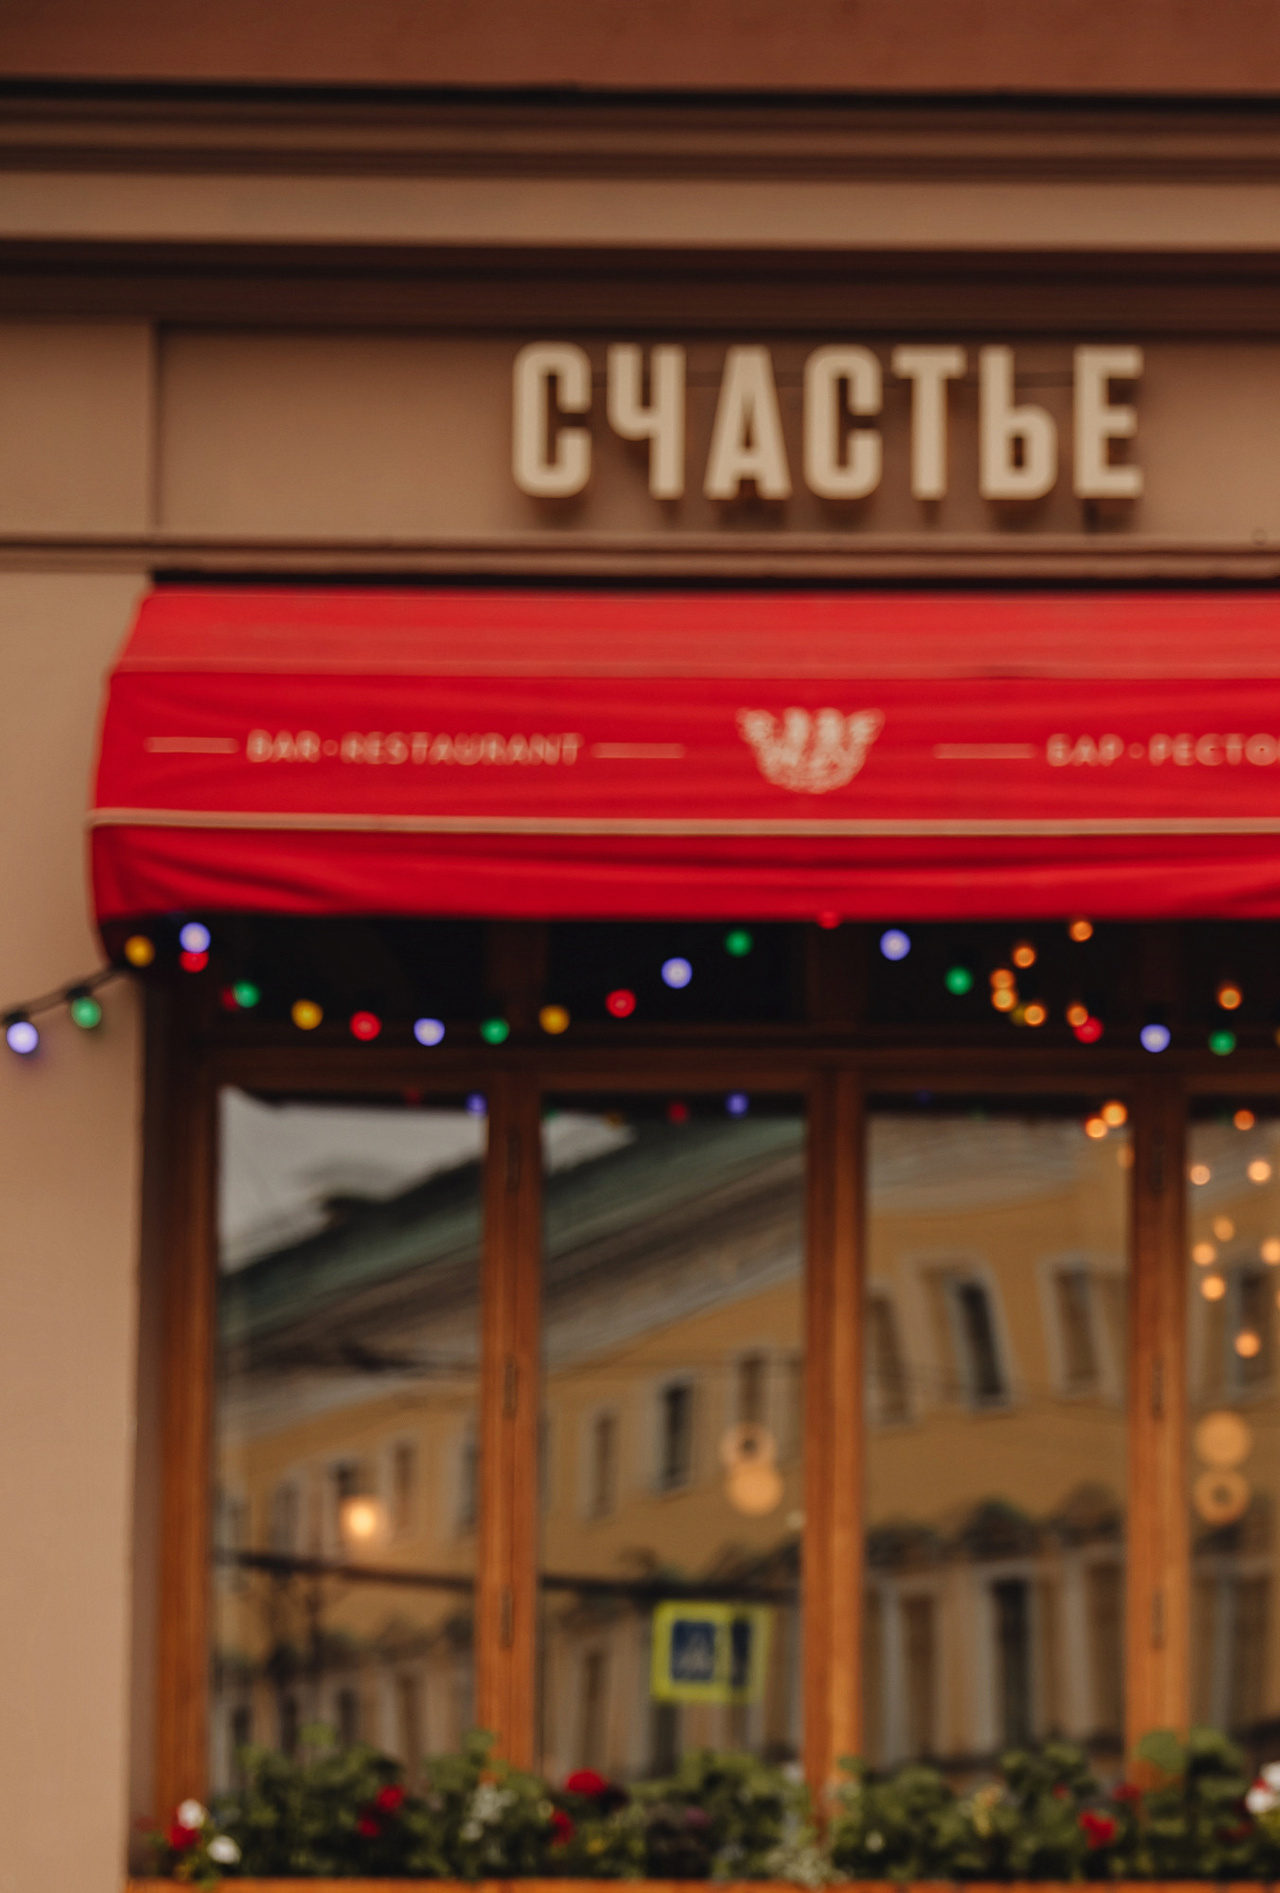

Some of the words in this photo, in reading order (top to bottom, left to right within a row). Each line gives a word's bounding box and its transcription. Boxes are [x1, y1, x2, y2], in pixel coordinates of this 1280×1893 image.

[512, 340, 1144, 501] СЧАСТЬЕ
[247, 730, 321, 762] BAR
[341, 731, 584, 765] RESTAURANT
[1046, 733, 1124, 766] БАР
